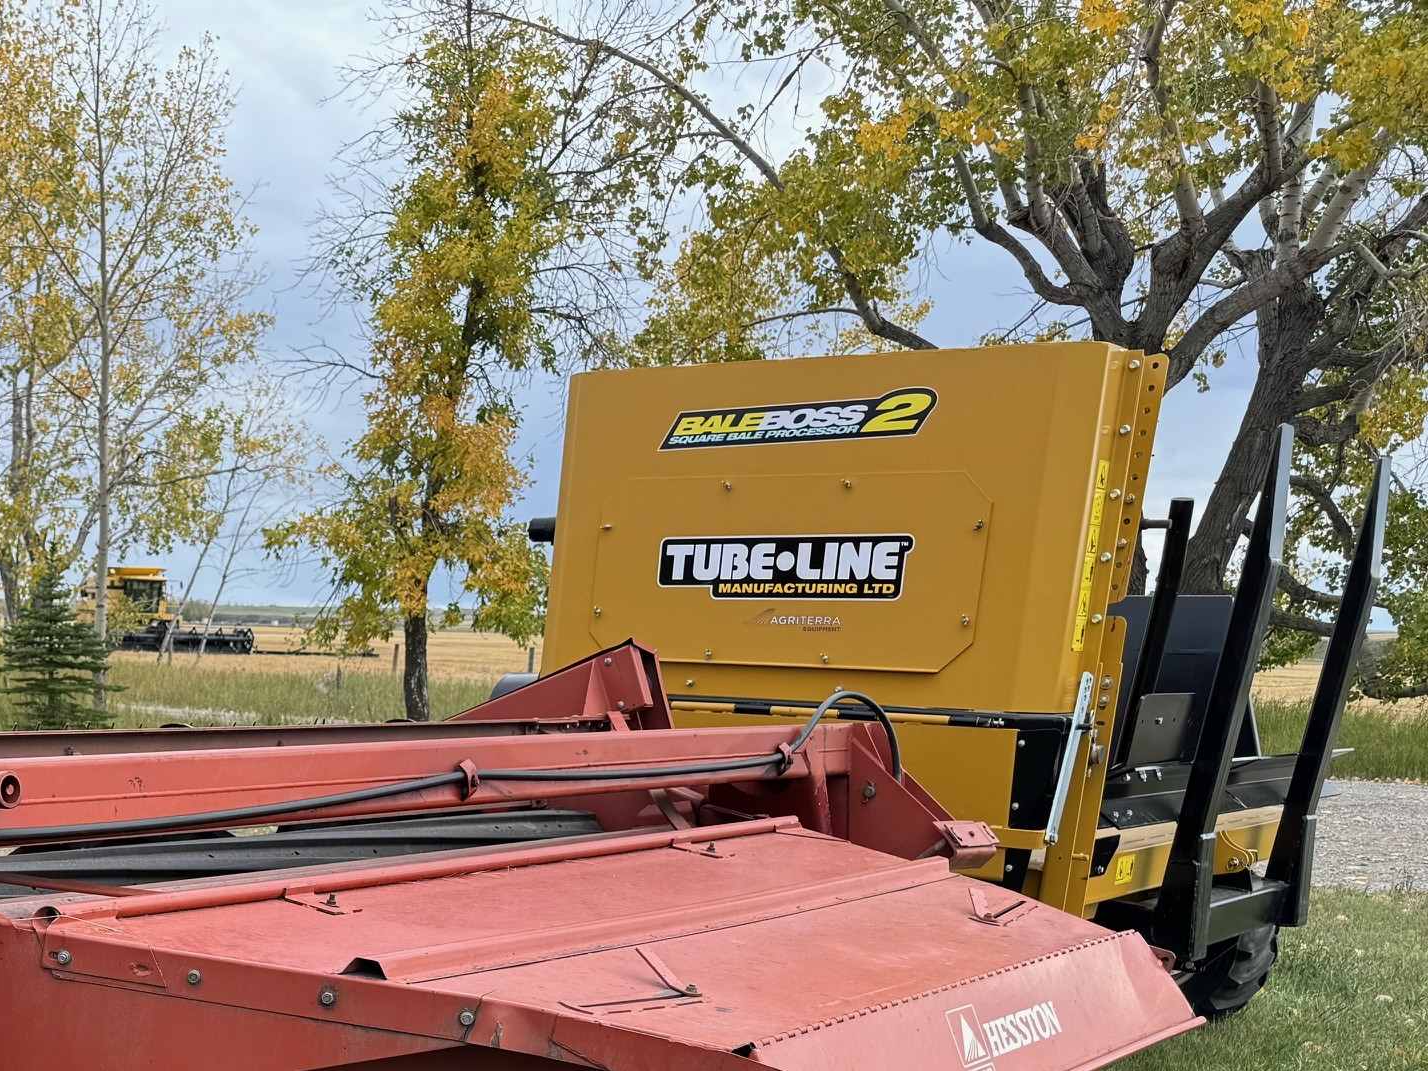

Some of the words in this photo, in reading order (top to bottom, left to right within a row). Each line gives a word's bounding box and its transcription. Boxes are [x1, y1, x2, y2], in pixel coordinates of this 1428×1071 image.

[860, 393, 932, 432] 2
[668, 433, 725, 445] SQUARE
[726, 431, 765, 441] BALE
[765, 425, 860, 439] PROCESSOR
[718, 583, 858, 595] MANUFACTURING
[863, 583, 895, 594] LTD
[770, 616, 841, 627] AGRITERRA
[982, 1000, 1062, 1058] HESSTON
